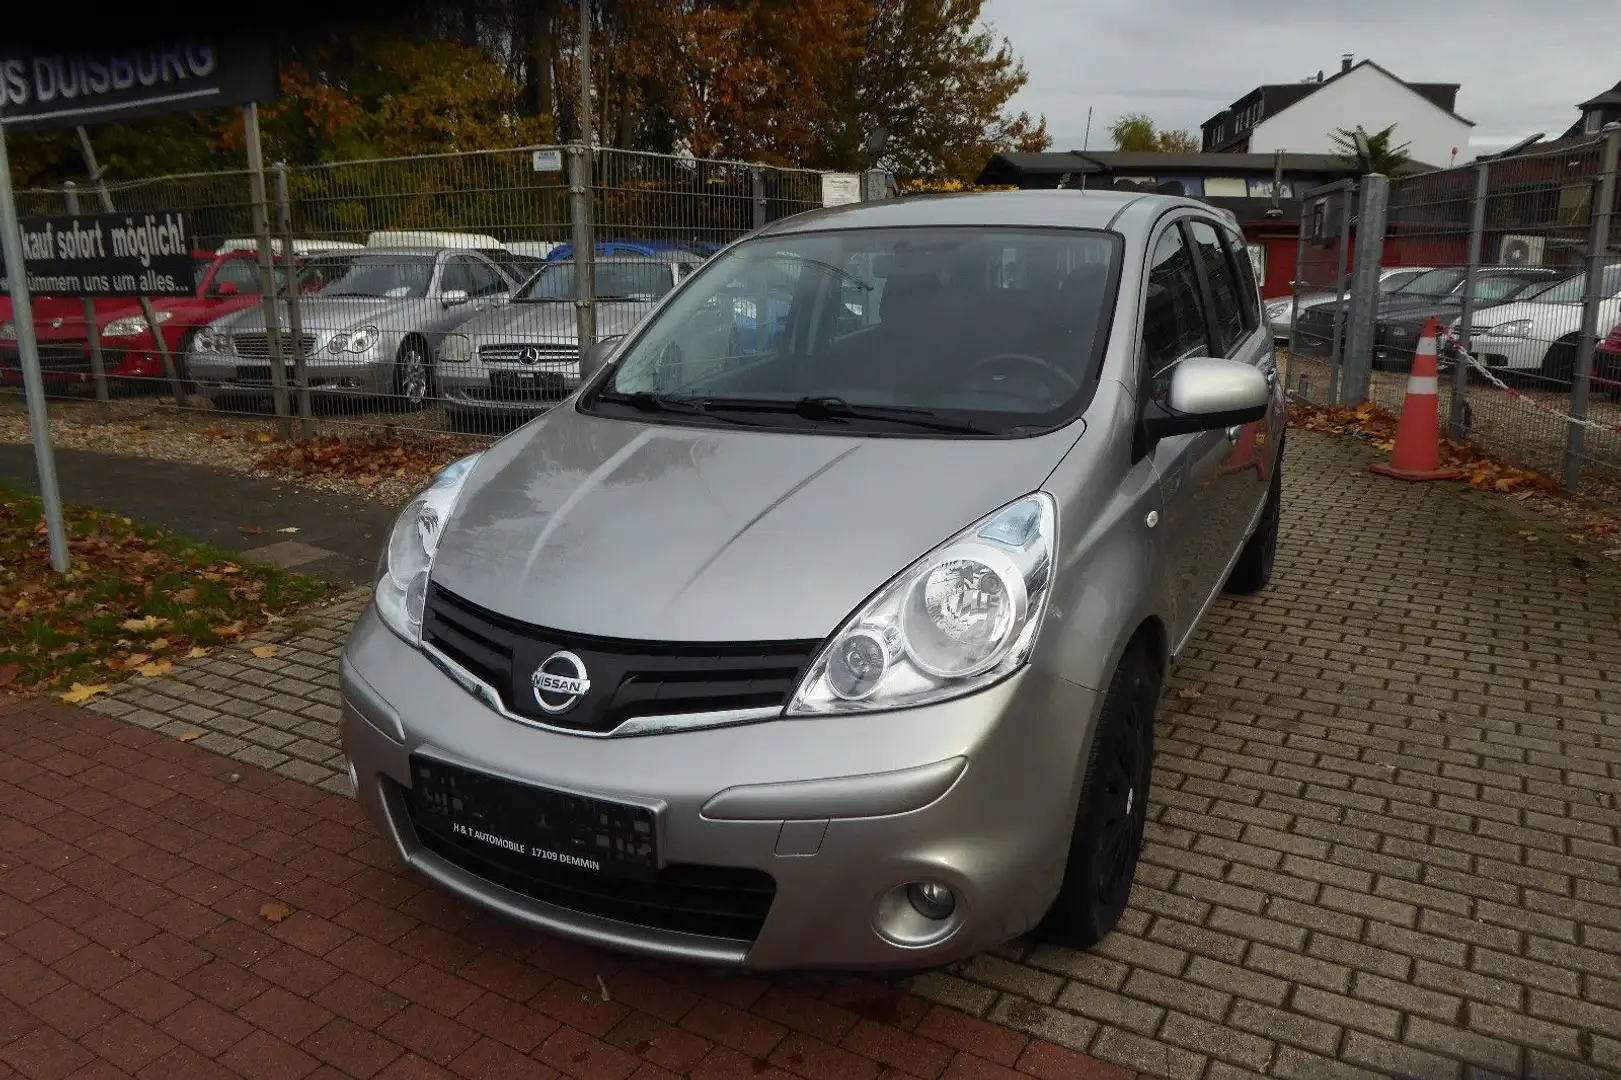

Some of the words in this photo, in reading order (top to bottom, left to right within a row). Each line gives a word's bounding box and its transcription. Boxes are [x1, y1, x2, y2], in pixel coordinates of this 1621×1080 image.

[34, 37, 216, 102] DUISBURG
[57, 220, 105, 260] sofort
[111, 213, 187, 267] möglich!
[83, 275, 110, 292] uns
[113, 275, 137, 292] um
[140, 269, 189, 292] alles...
[533, 674, 581, 692] NISSAN
[453, 823, 460, 833] H
[460, 826, 468, 836] &
[468, 828, 474, 838] T
[474, 830, 525, 854] AUTOMOBILE
[531, 847, 558, 861] 17109
[559, 853, 600, 871] DEMMIN
